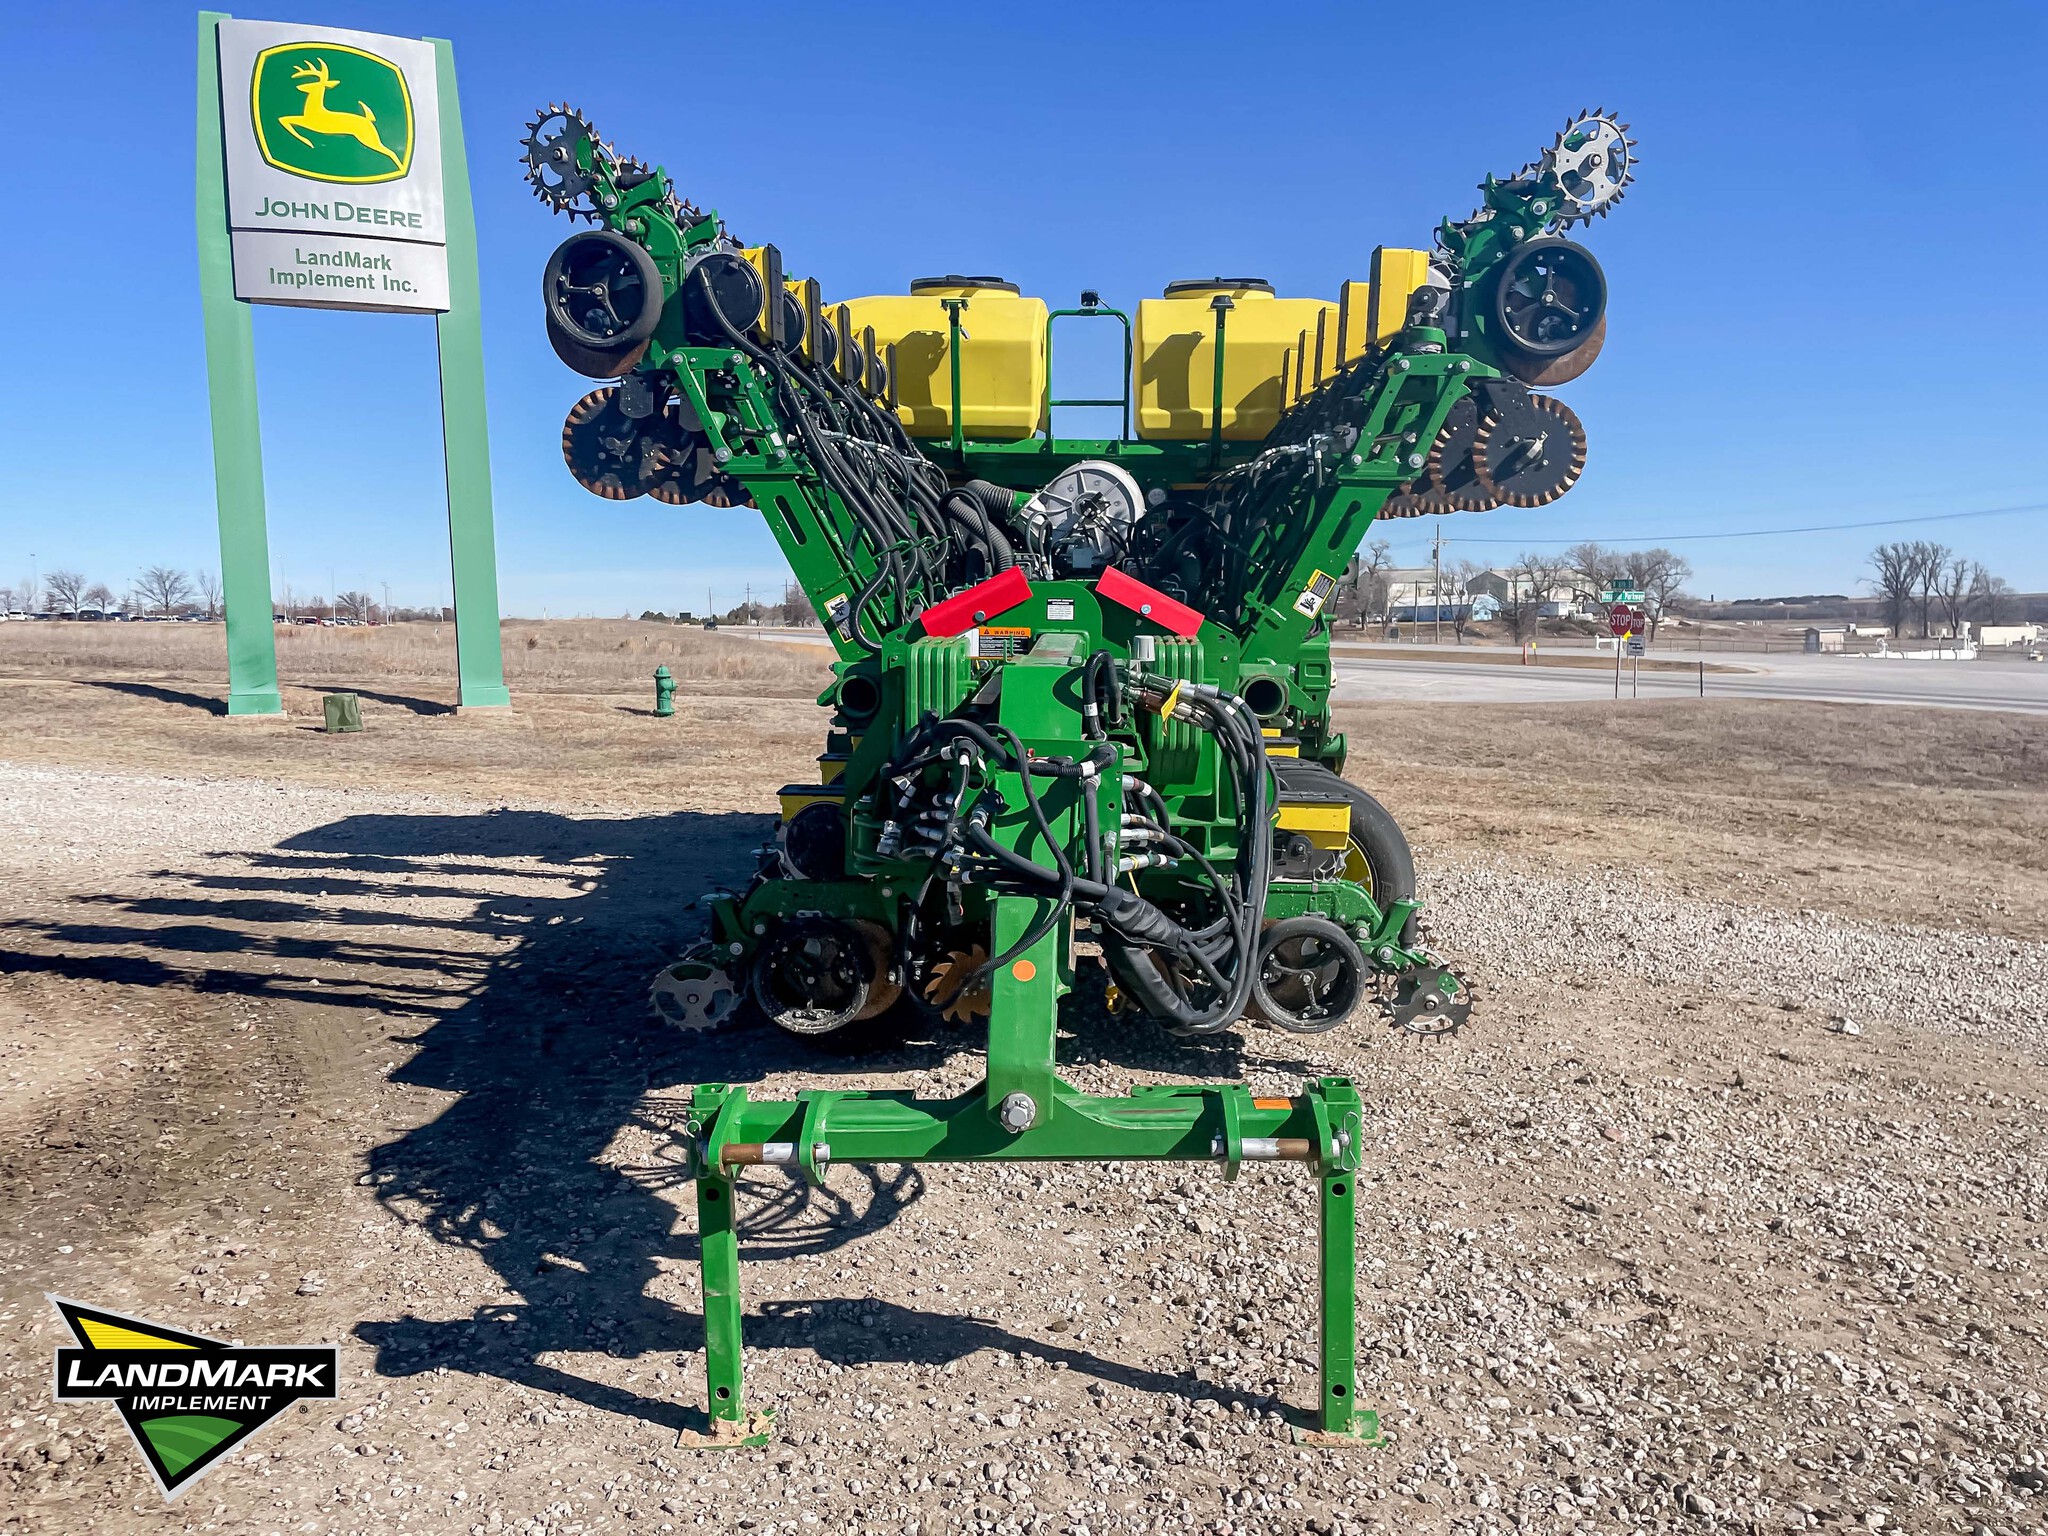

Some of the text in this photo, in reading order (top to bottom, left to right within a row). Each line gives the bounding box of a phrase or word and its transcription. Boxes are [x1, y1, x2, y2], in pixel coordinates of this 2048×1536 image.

[255, 197, 423, 229] JOHN DEERE
[295, 248, 392, 271] LandMark
[269, 267, 418, 293] Implement Inc.
[1611, 614, 1631, 626] STOP
[1632, 619, 1644, 628] TOP
